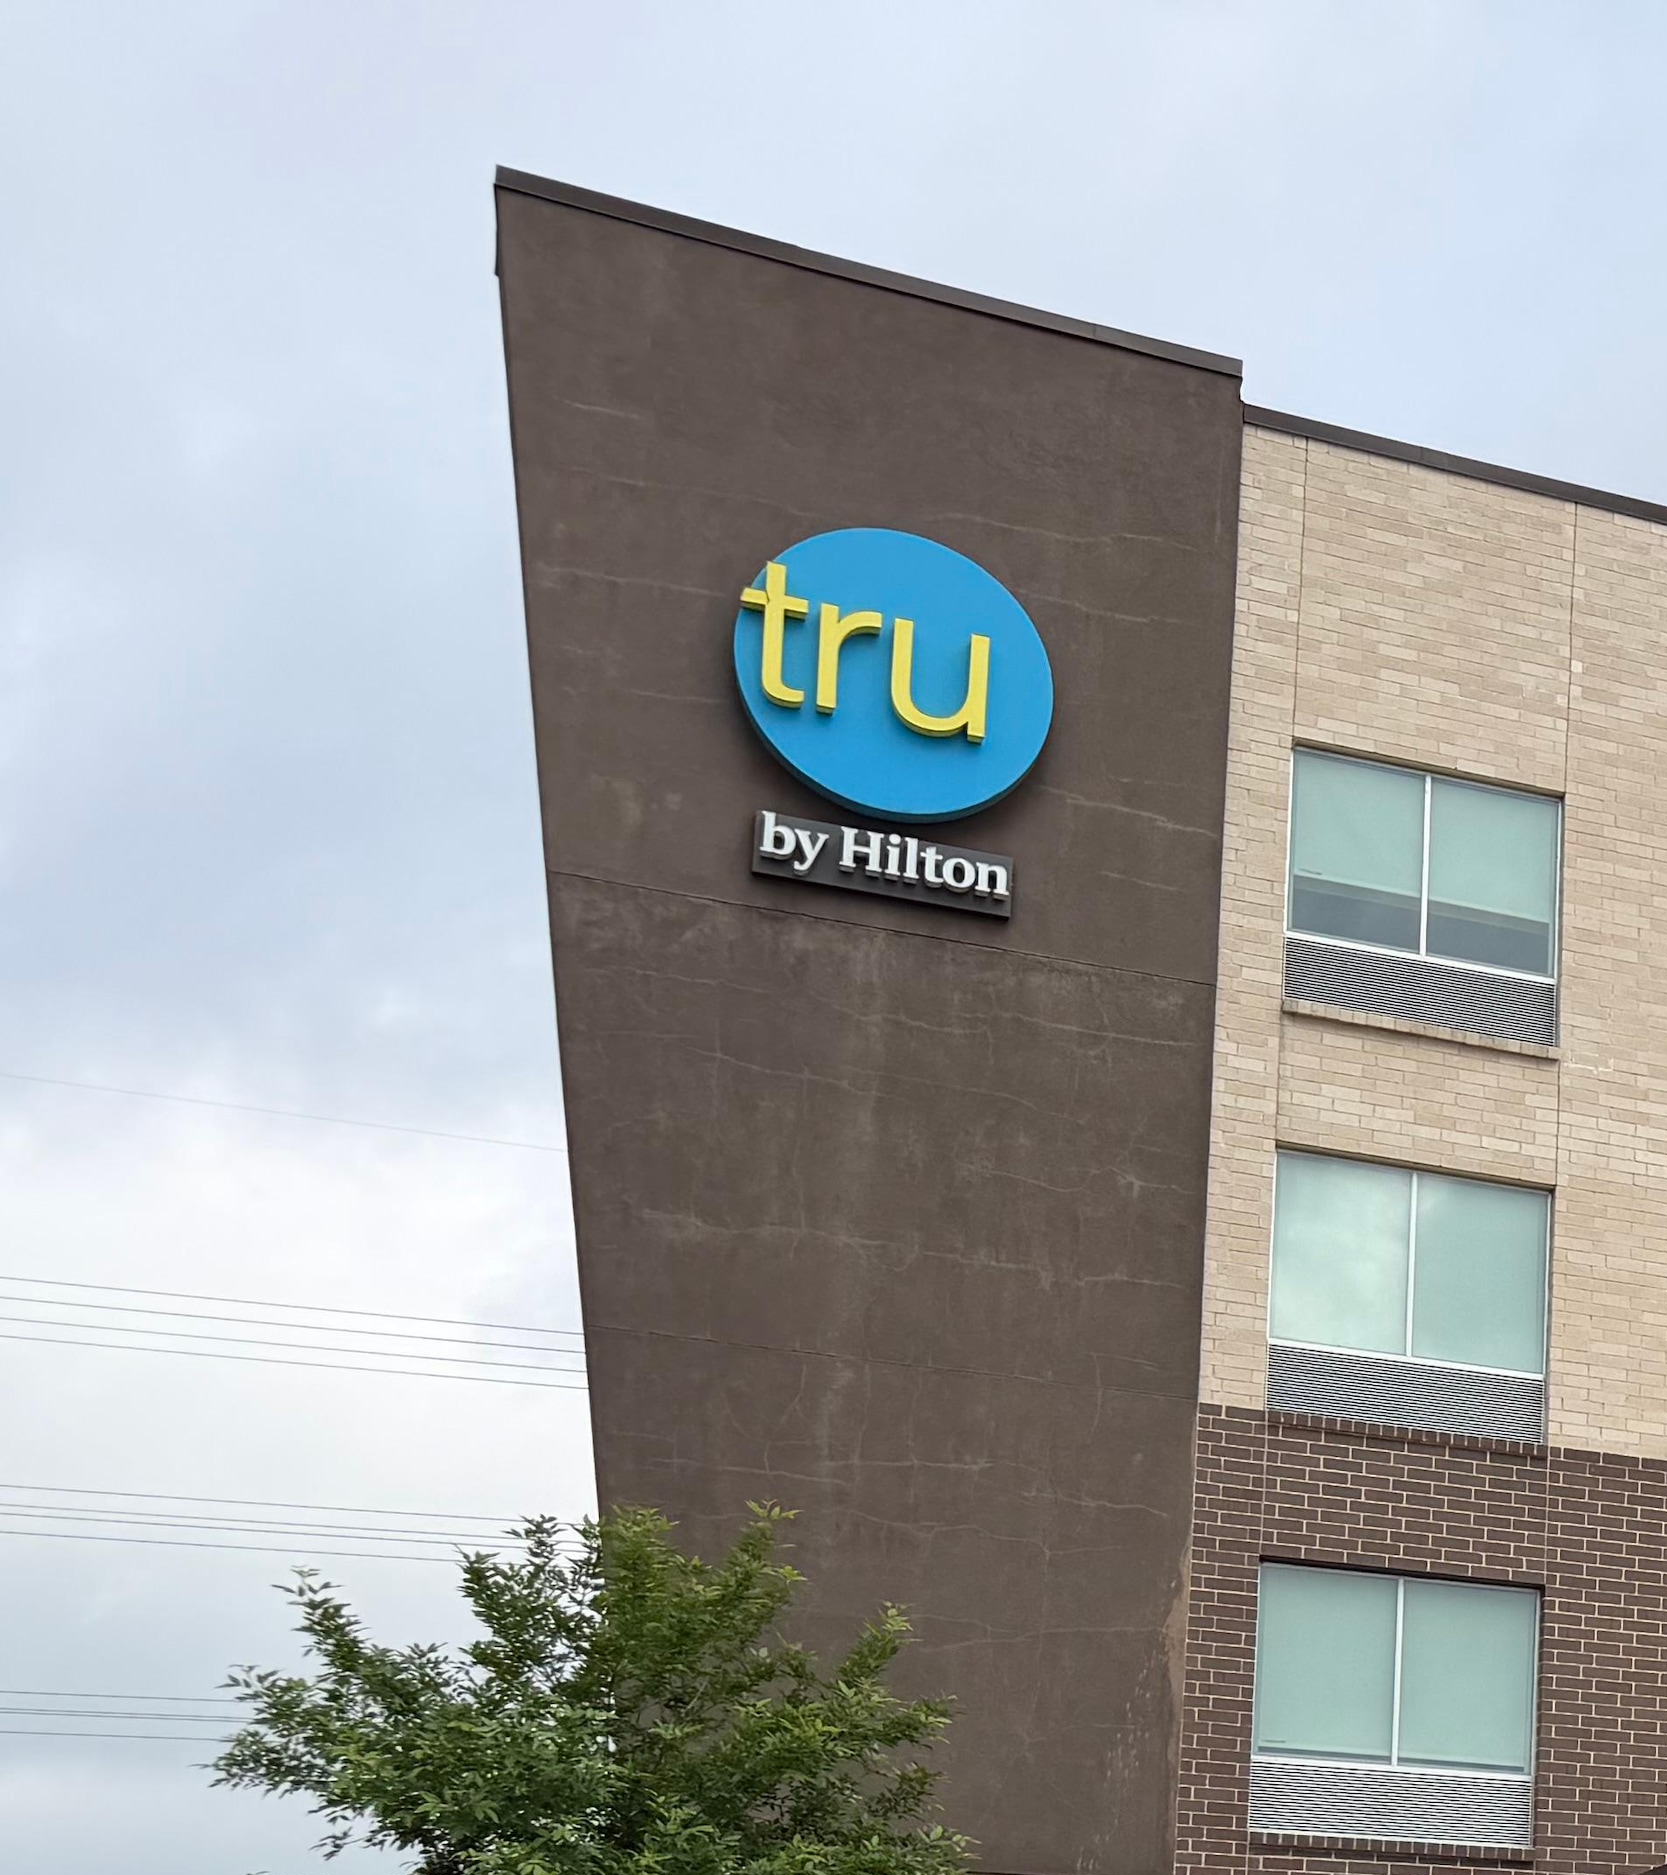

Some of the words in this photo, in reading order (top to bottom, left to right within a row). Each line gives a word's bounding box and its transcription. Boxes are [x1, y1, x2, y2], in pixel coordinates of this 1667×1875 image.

[740, 560, 991, 744] tru
[759, 810, 828, 877] by
[838, 826, 1010, 900] Hilton
